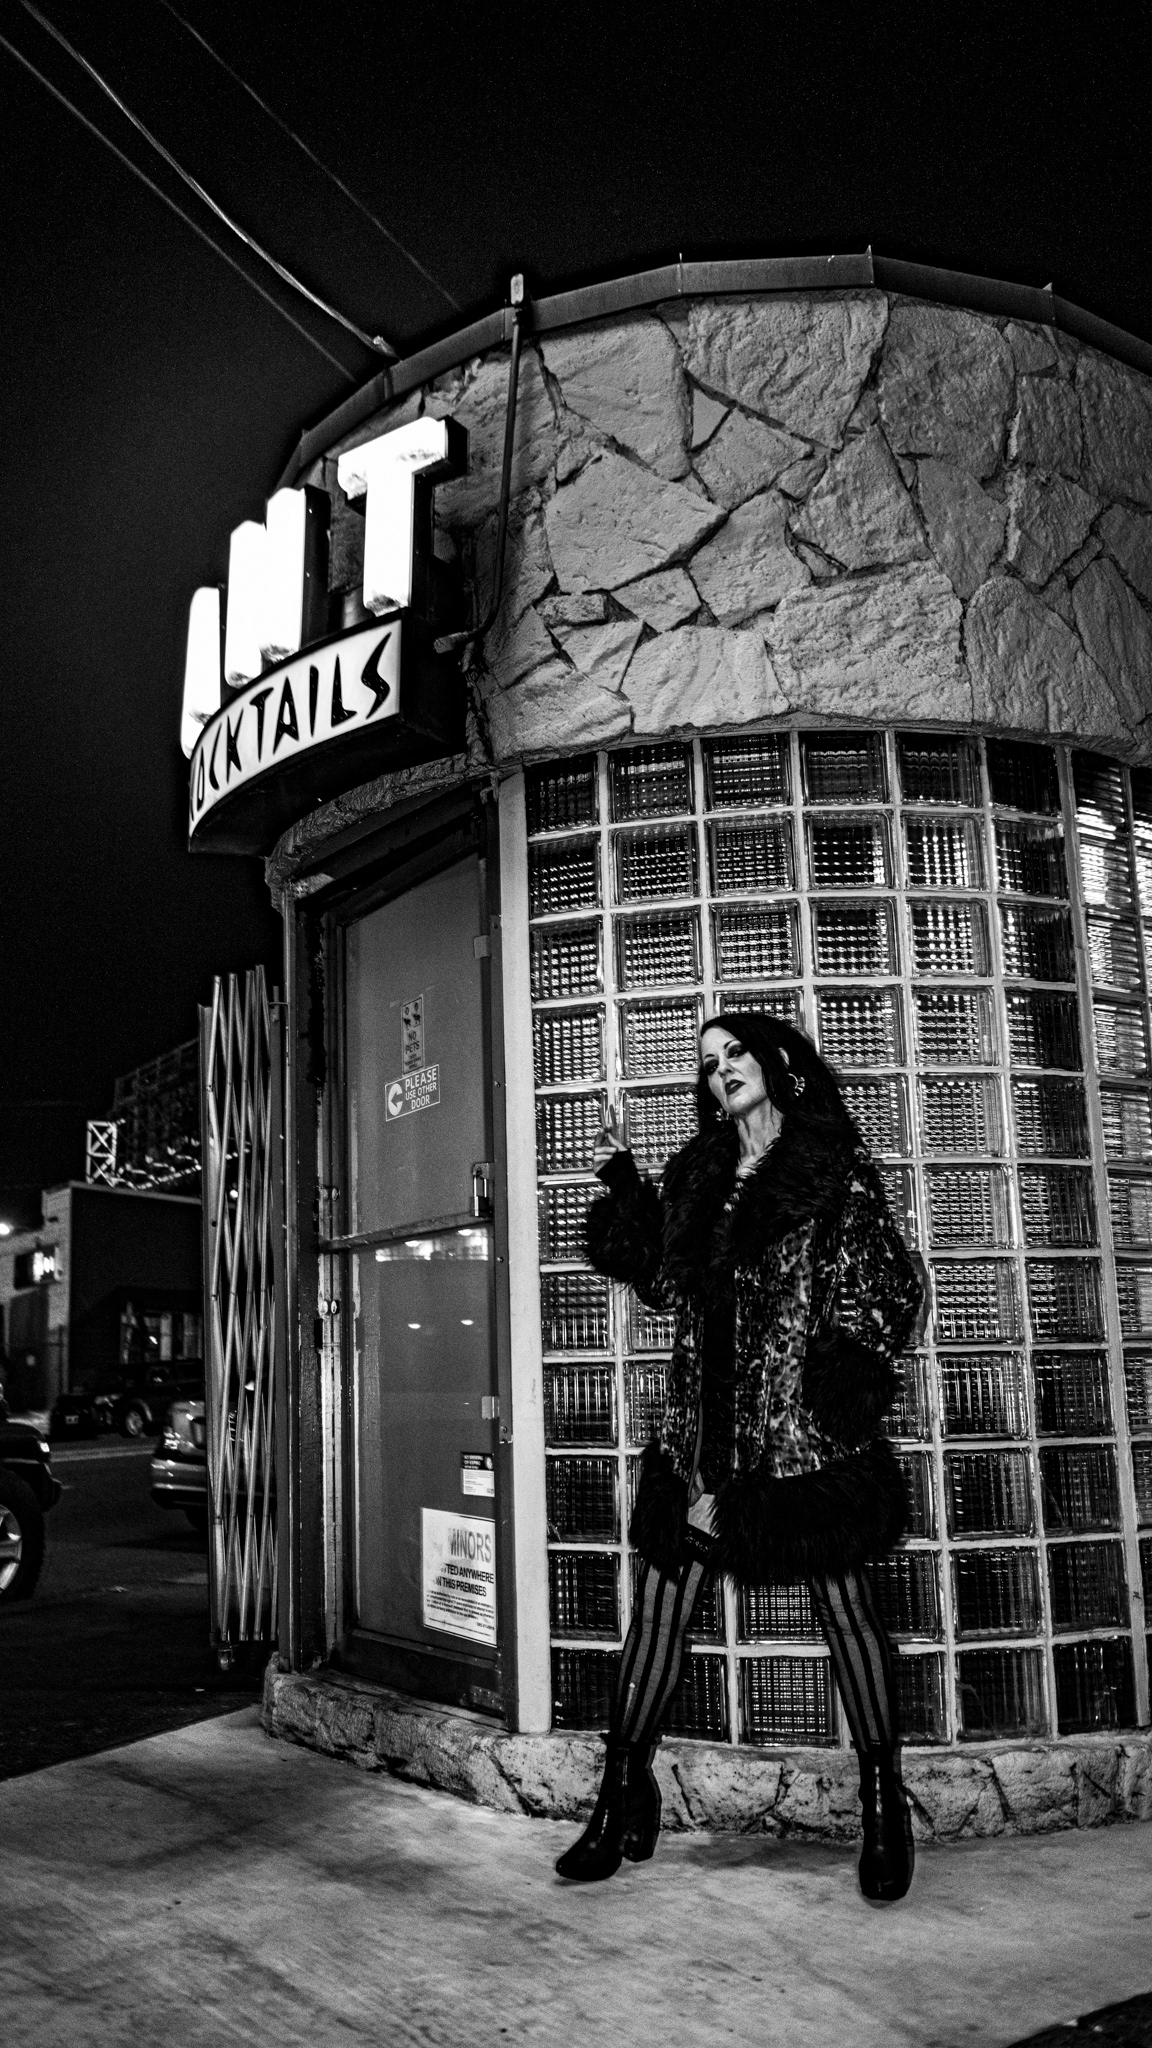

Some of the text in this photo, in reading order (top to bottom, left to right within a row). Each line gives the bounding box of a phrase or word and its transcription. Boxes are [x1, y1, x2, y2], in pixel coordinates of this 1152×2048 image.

[408, 1031, 417, 1043] NO
[405, 1041, 420, 1055] PETS
[405, 1068, 437, 1091] PLEASE
[405, 1082, 437, 1101] USE OTHER
[411, 1094, 431, 1110] DOOR
[459, 1566, 495, 1584] ANYWHERE
[441, 1576, 456, 1590] THIS
[455, 1579, 487, 1597] PREMISES
